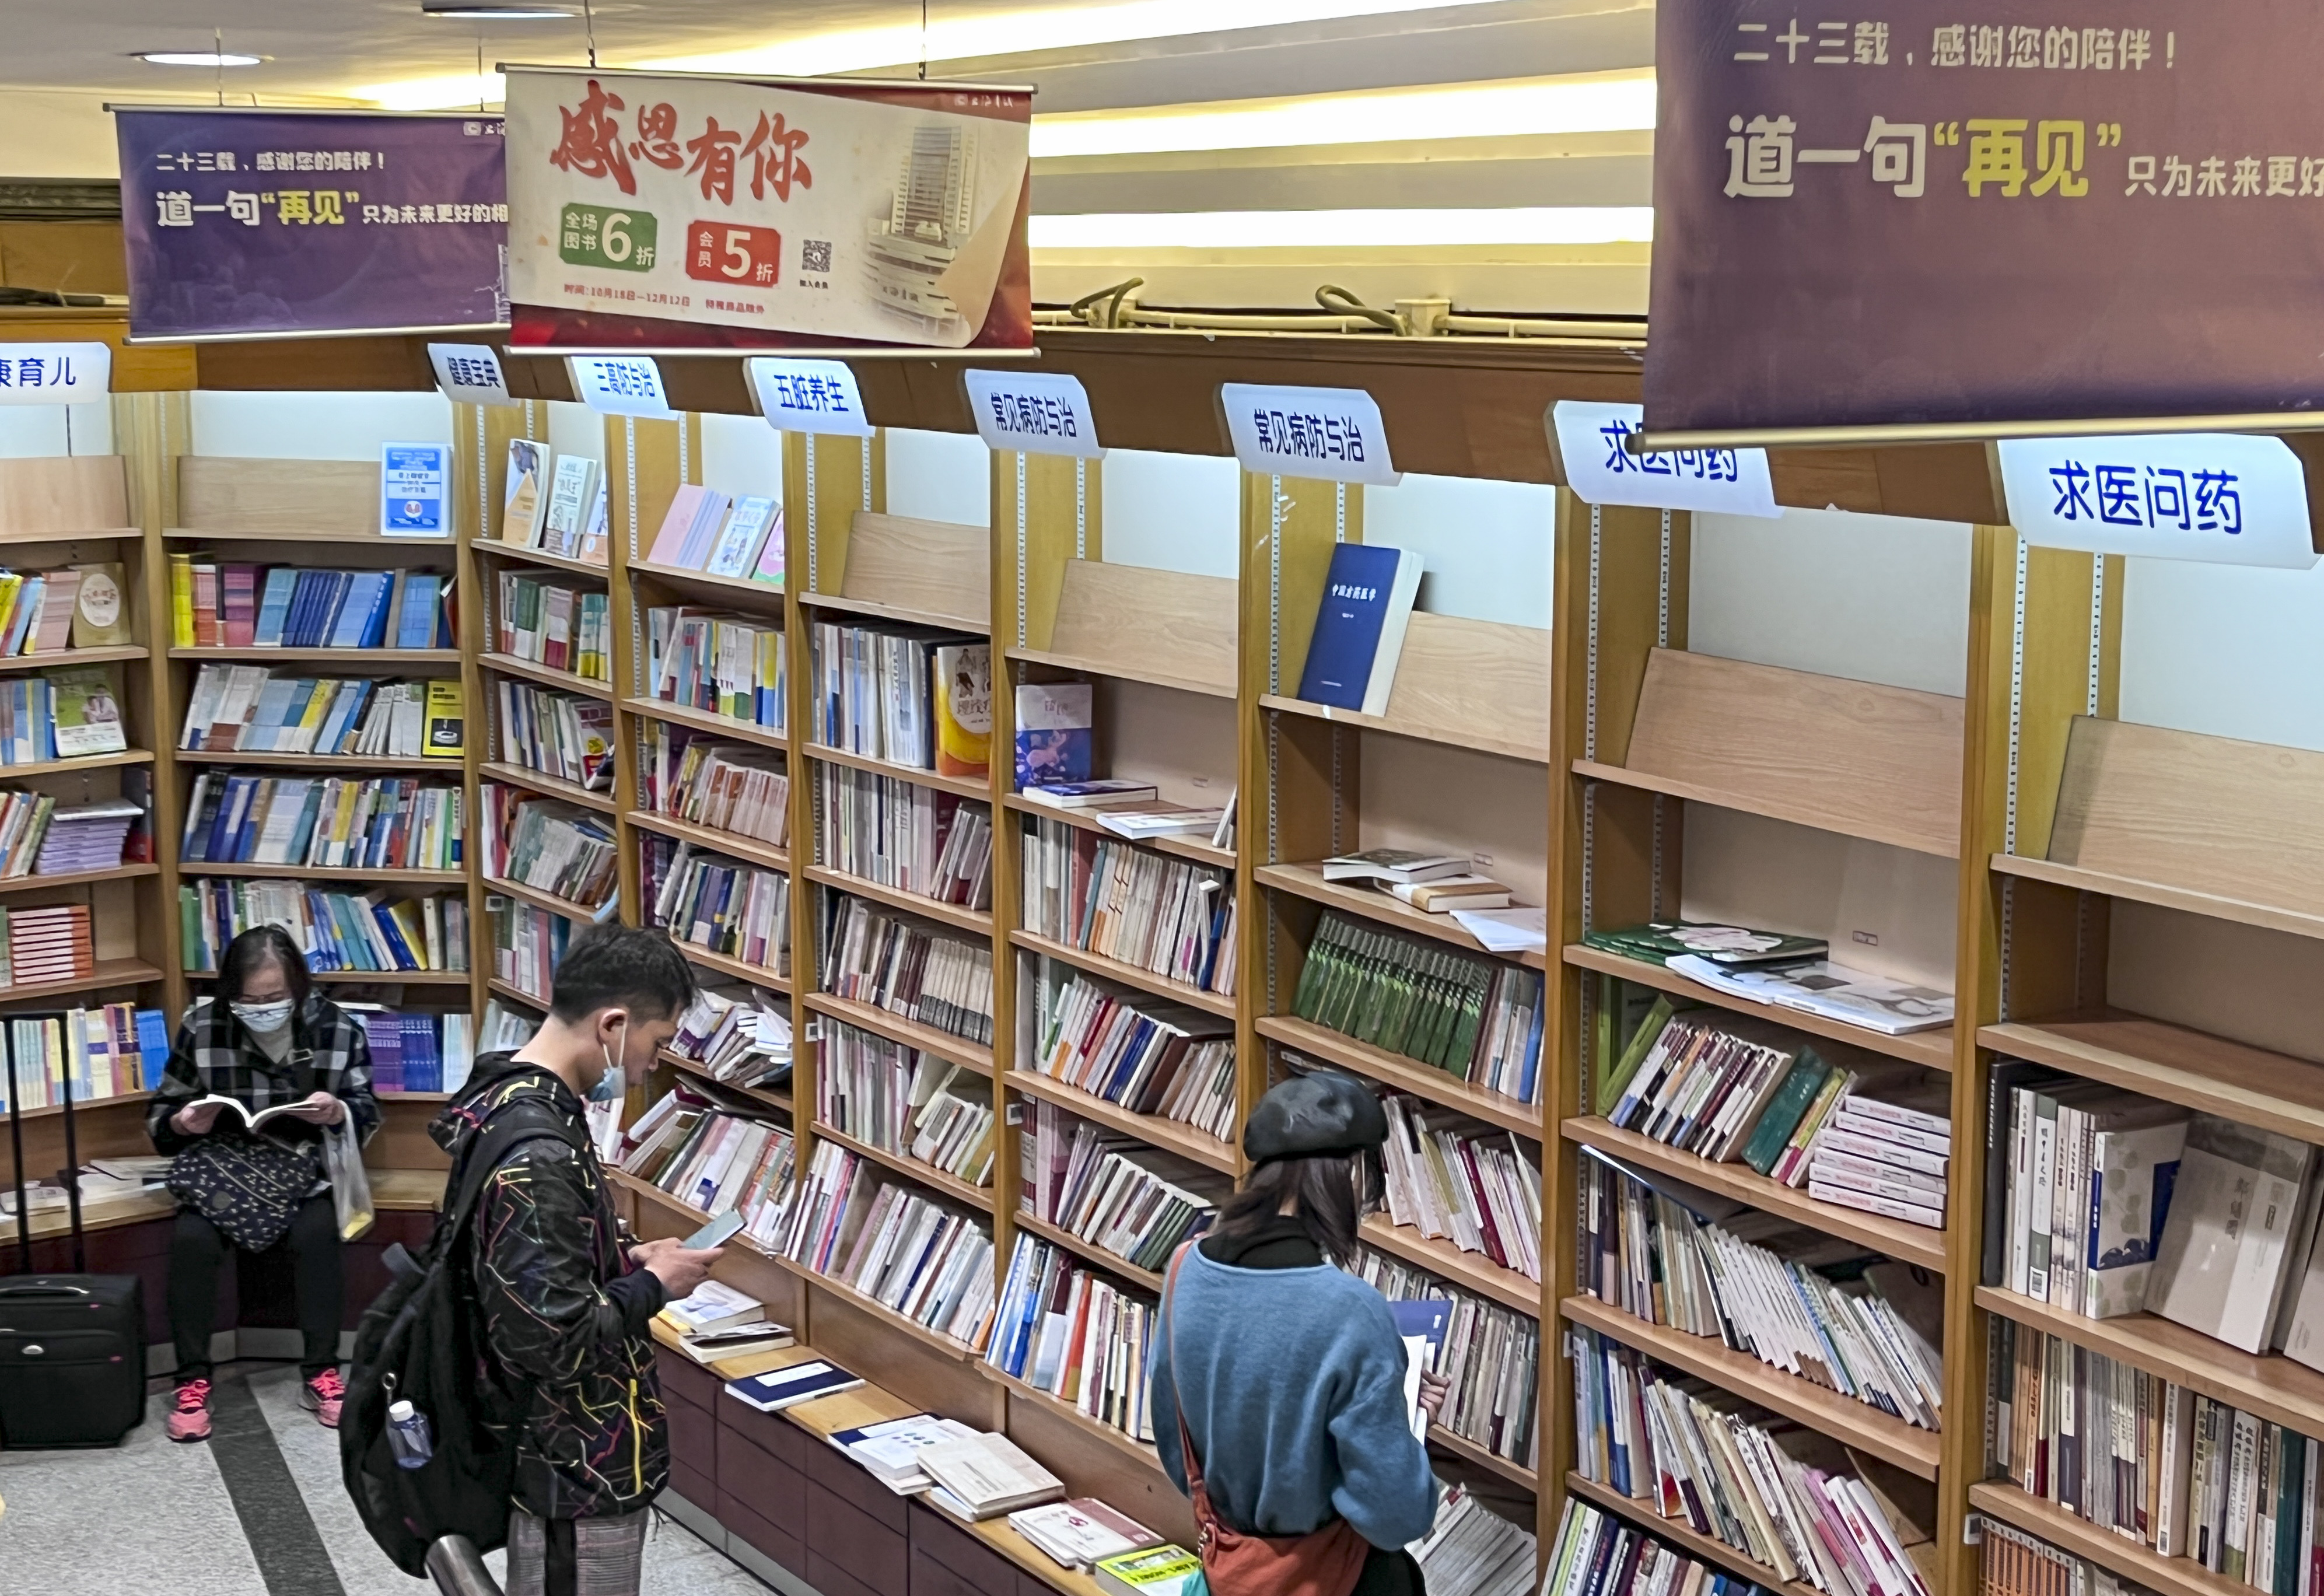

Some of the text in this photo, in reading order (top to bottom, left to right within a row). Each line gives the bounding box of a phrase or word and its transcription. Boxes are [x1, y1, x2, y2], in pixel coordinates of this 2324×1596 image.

[550, 79, 812, 205] 感恩有你
[2124, 155, 2324, 197] 只为未来更好
[564, 231, 597, 251] 图书
[565, 212, 598, 231] 全场
[776, 373, 850, 414] 五脏养生
[991, 391, 1077, 439] 常见病防与治
[1254, 408, 1365, 463] 常见病防与治
[2049, 459, 2244, 535] 求医问药
